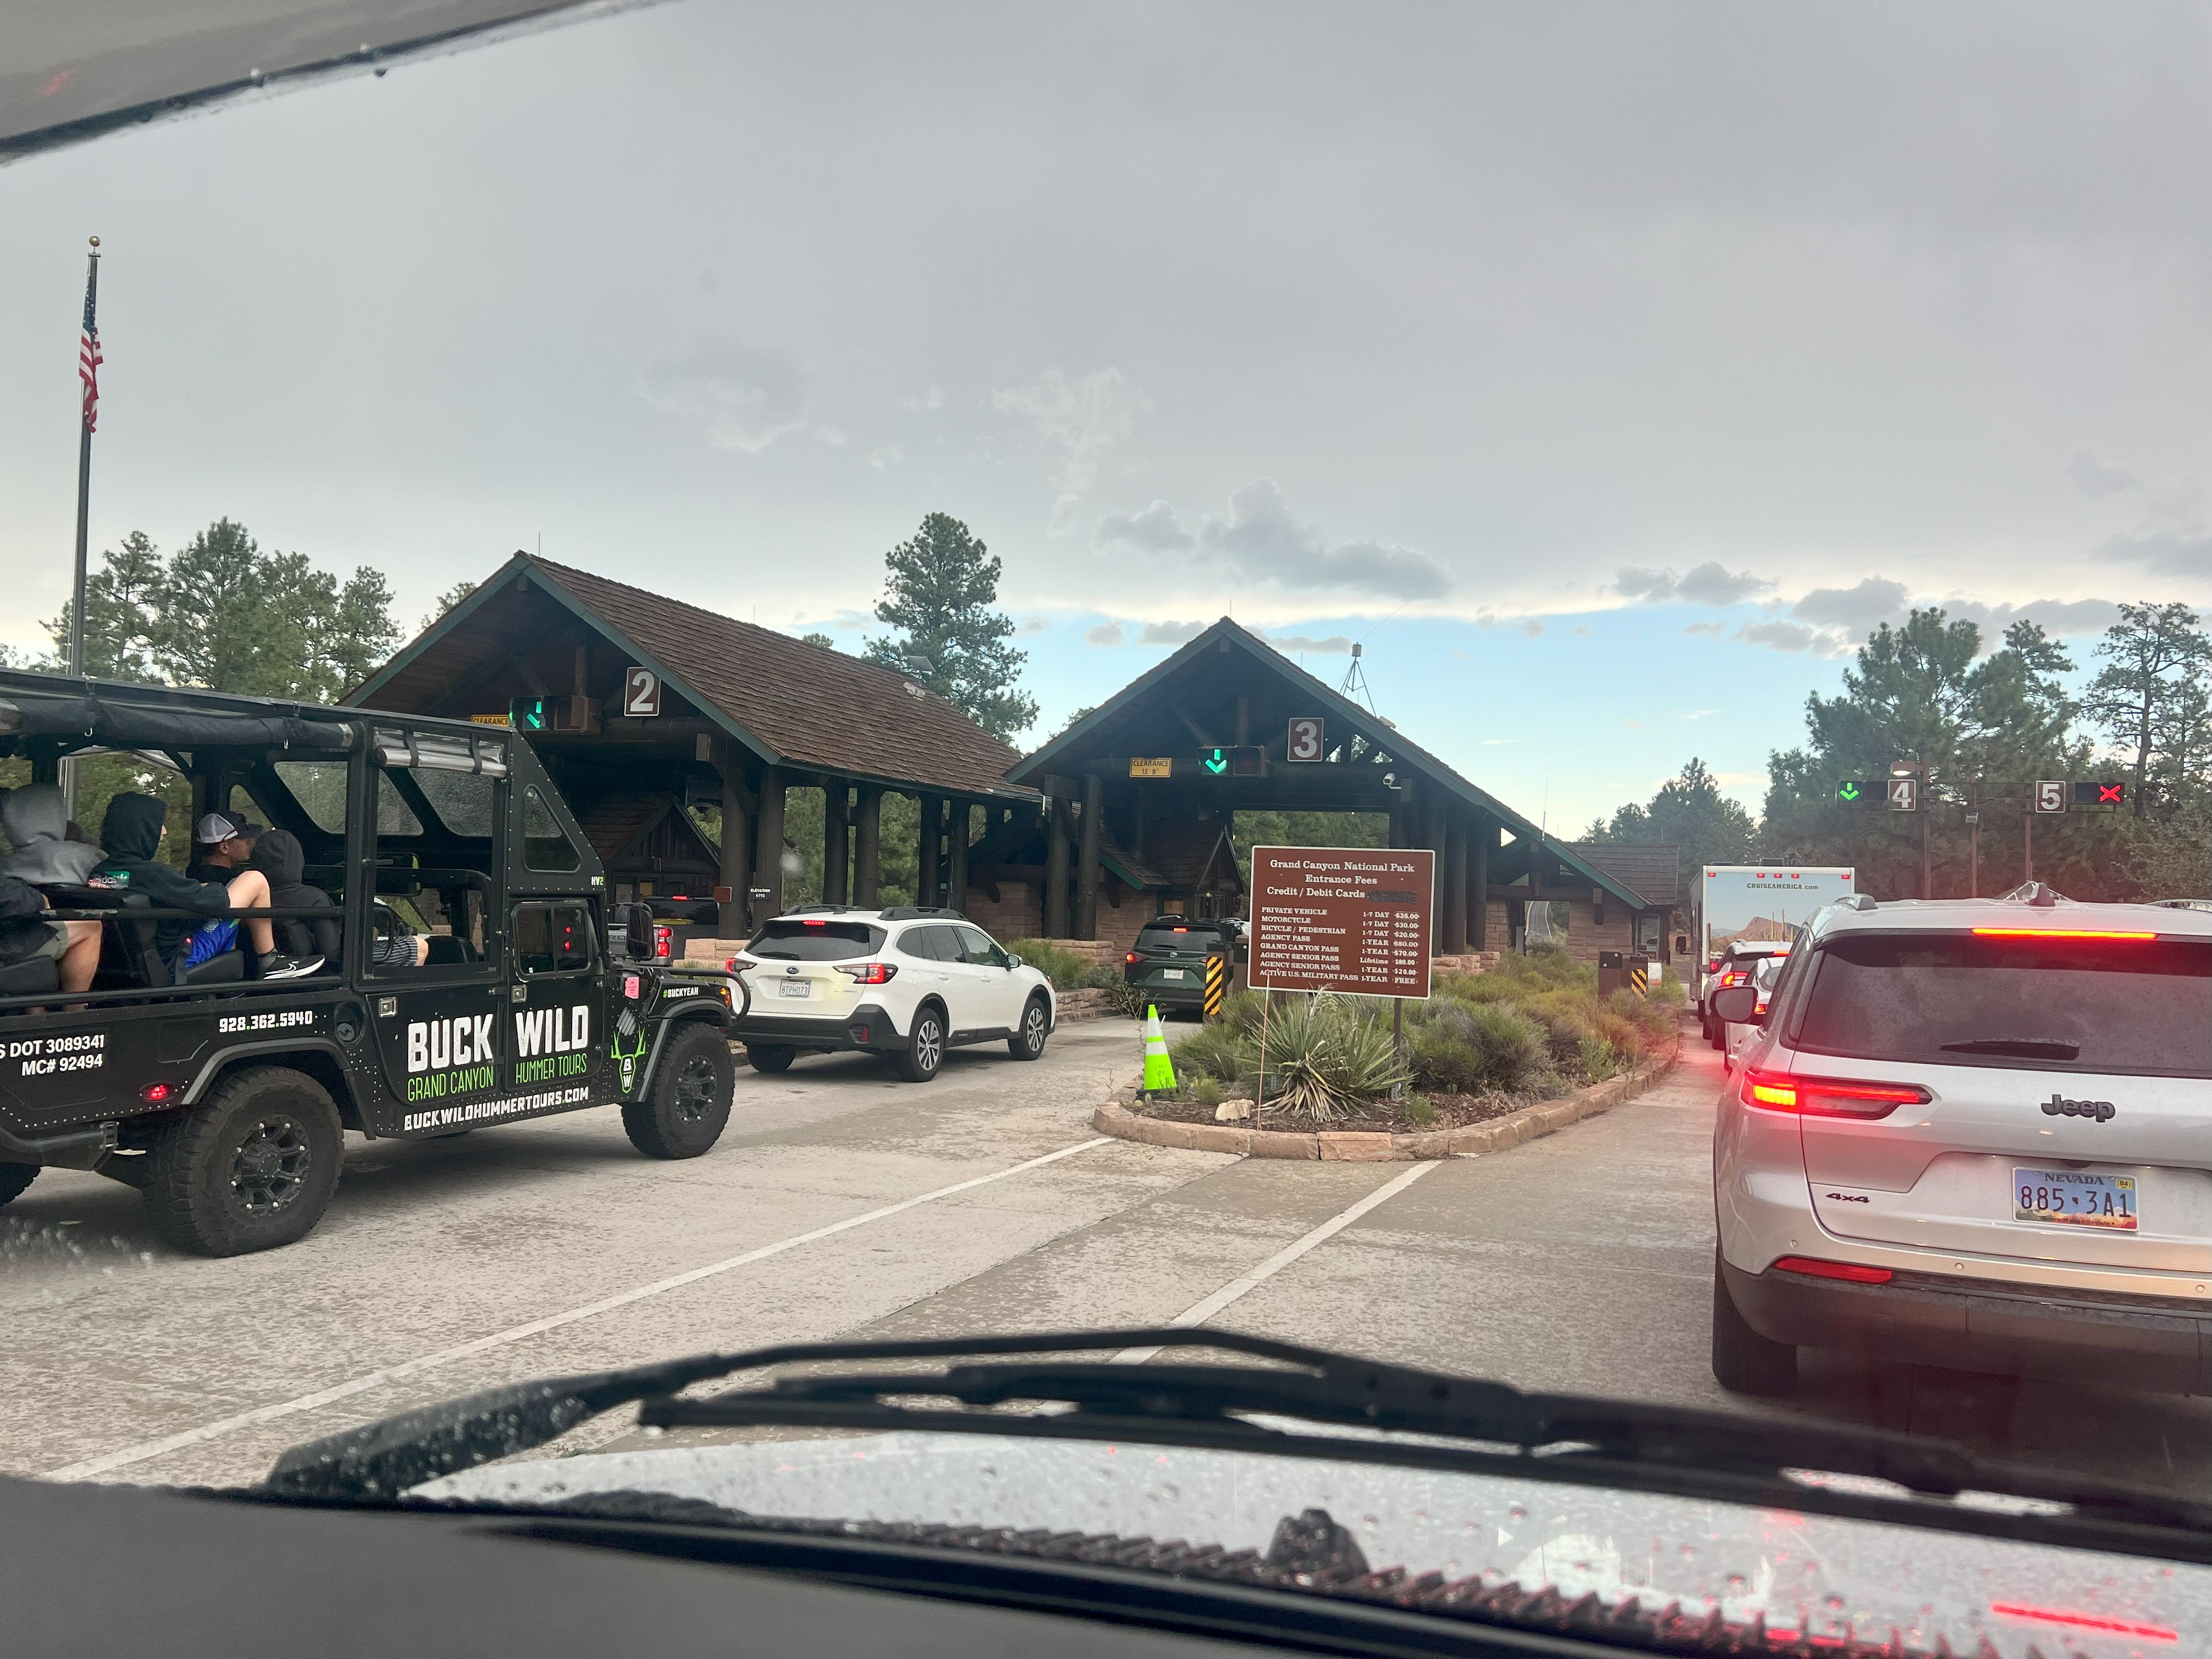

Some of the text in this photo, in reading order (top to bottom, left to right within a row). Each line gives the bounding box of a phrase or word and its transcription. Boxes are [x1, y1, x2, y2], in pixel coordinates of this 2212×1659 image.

[630, 671, 655, 712] 2
[473, 716, 509, 725] CLEARANCE
[1293, 721, 1318, 758] 3
[1892, 782, 1912, 808] 4
[2040, 783, 2061, 810] 5
[1270, 859, 1415, 872] Grand Canyon National Park
[591, 876, 603, 885] HV2
[1305, 874, 1378, 884] Entrance Fees
[1267, 886, 1298, 895] Credit
[1306, 888, 1333, 897] Debit
[1335, 889, 1365, 898] Cards
[1261, 916, 1311, 924] MOTORCYCLE
[1298, 926, 1346, 934] PEDESTRIAN
[1290, 962, 1320, 970] SENIOR
[1301, 972, 1339, 980] MILITARY
[663, 987, 699, 998] #BUCKYEAH
[219, 1010, 314, 1034] 928.362.5940
[407, 1005, 589, 1073] BUCK WILD
[9, 1040, 43, 1058] DOT
[46, 1034, 105, 1054] 3089341
[21, 1053, 103, 1076] MC# 92494
[623, 1058, 632, 1071] B
[407, 1052, 588, 1102] GRAND CANYON HUMMER TOURS
[623, 1074, 632, 1088] W
[403, 1086, 590, 1131] BUCKWILDHUMMERTOURS.COM
[2040, 1093, 2116, 1123] Jeep
[2044, 1172, 2105, 1185] NEVADA
[1825, 1193, 1870, 1203] 4x4
